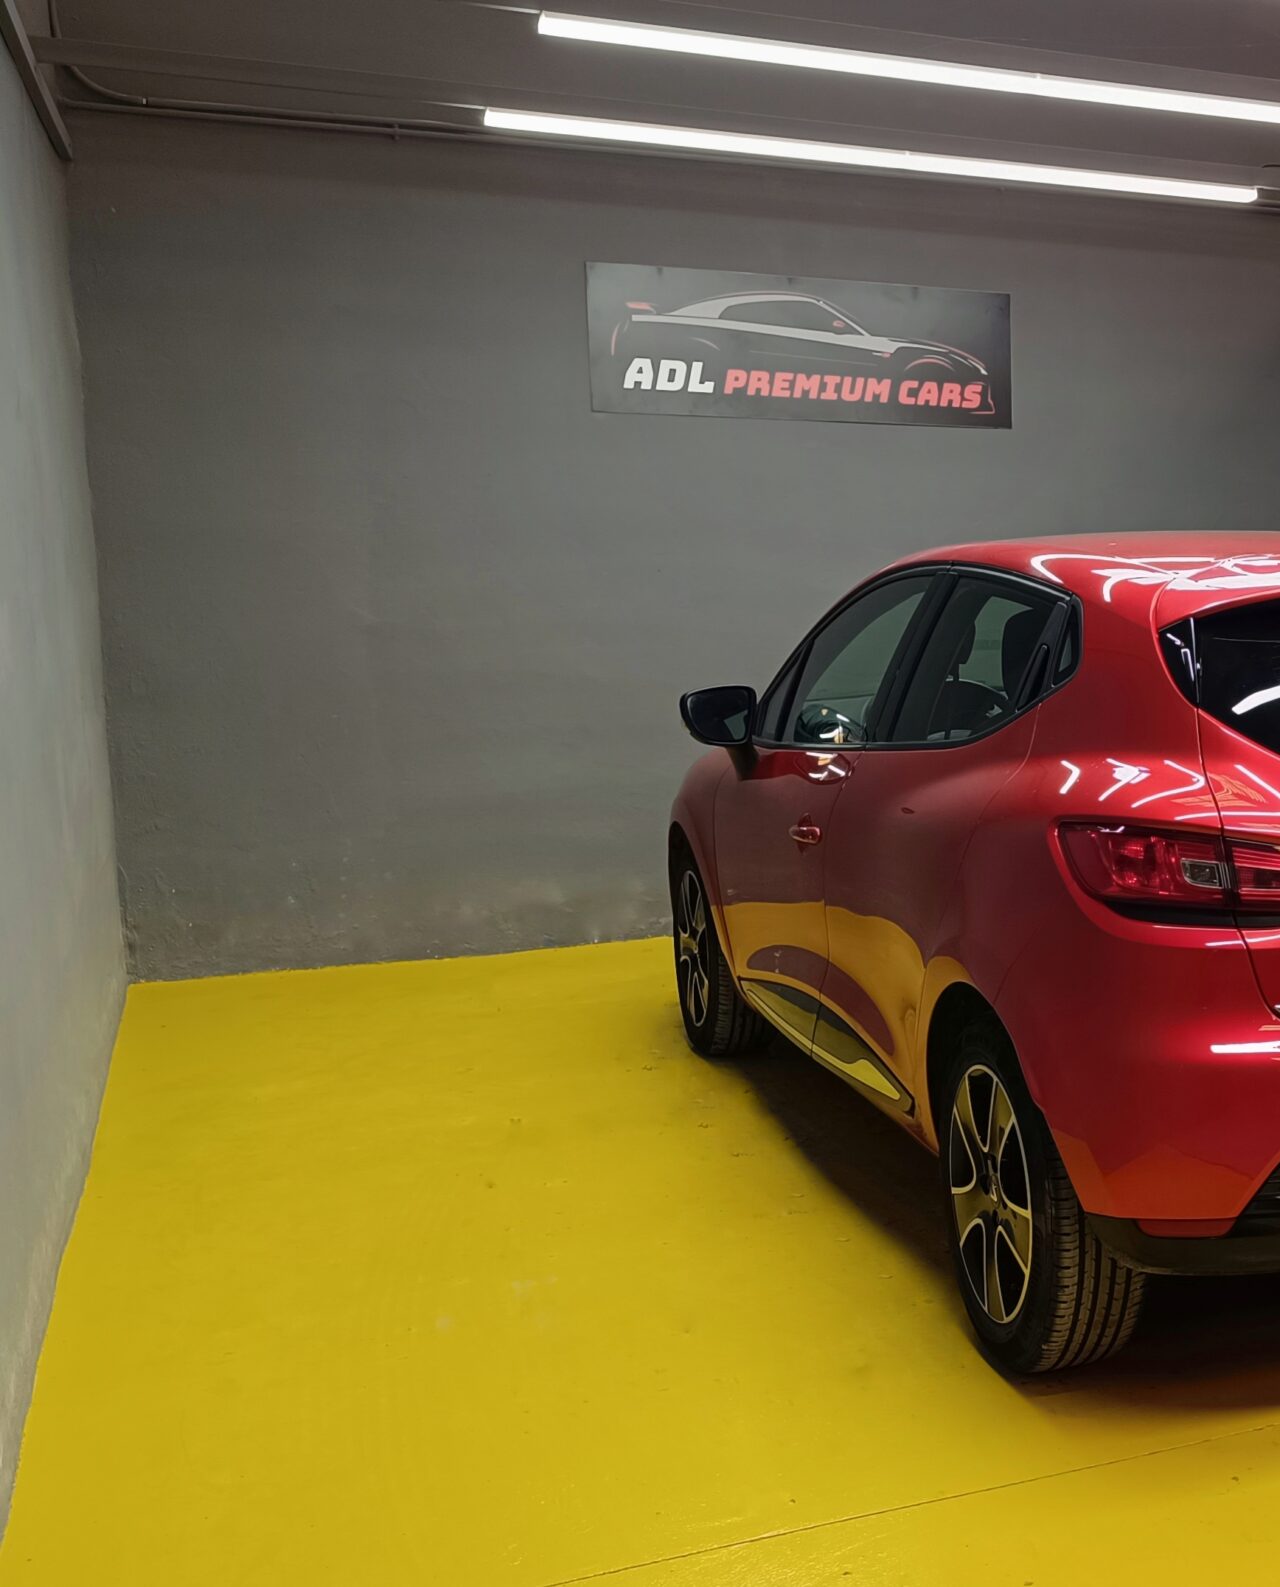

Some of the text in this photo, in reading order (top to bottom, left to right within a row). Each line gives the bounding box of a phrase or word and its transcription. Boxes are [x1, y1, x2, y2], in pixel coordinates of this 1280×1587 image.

[623, 357, 982, 408] ADL PREMIUM CARS
